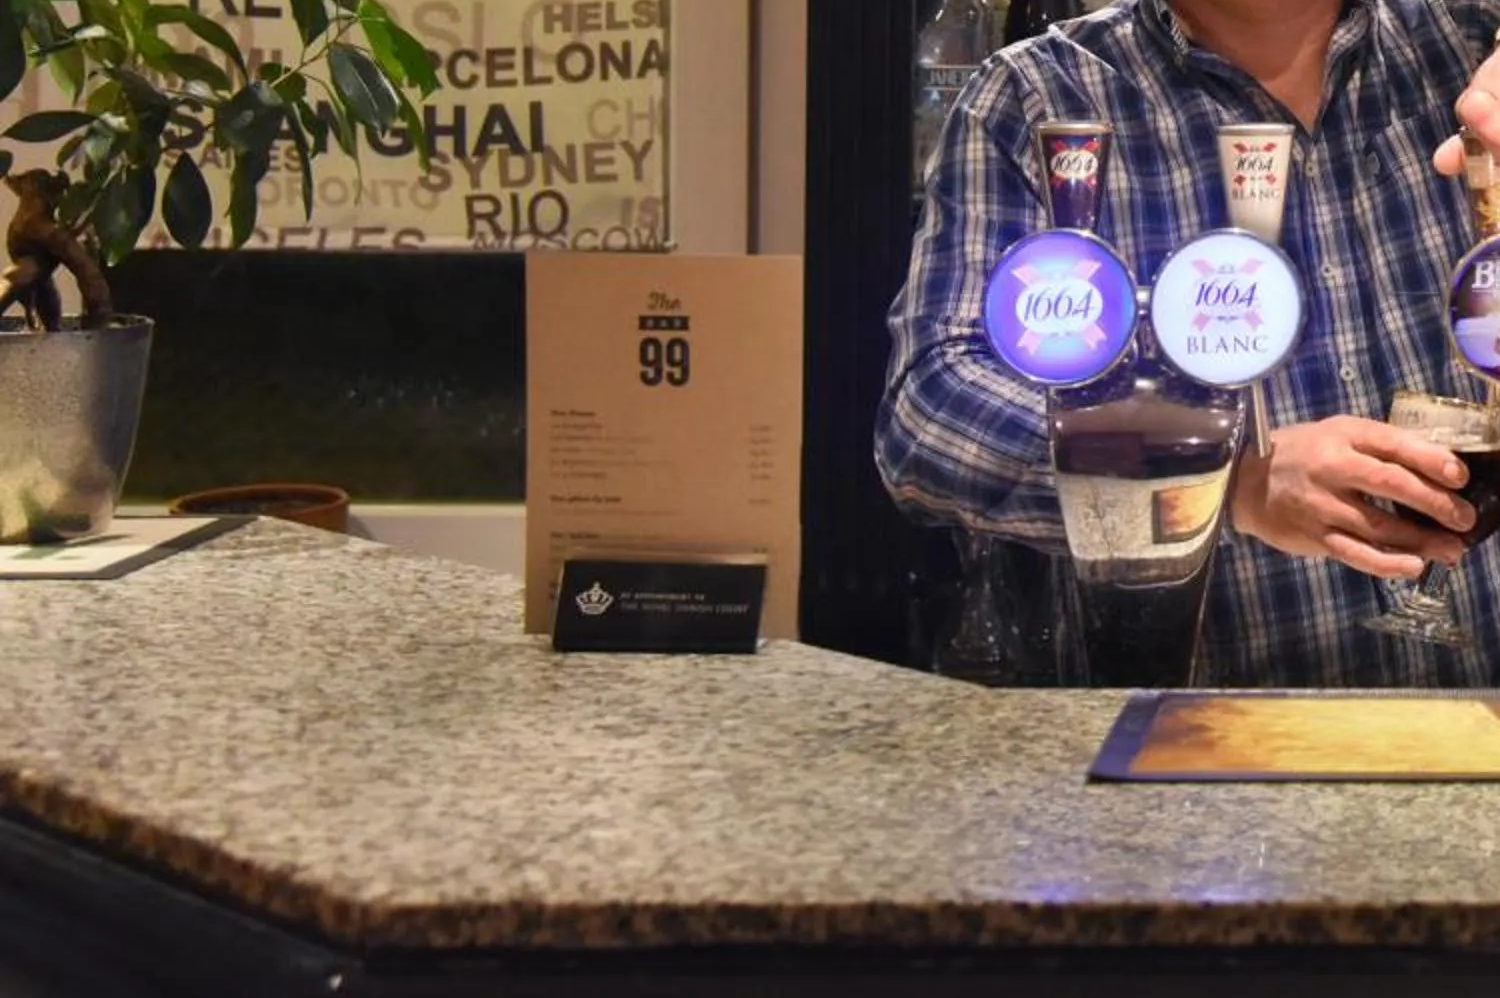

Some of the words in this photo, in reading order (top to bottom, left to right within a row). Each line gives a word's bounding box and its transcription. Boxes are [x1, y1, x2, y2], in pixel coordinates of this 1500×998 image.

[419, 139, 653, 193] SYDNEY
[1232, 186, 1280, 201] BLANC
[465, 189, 569, 241] RIO
[1024, 287, 1094, 322] 1664
[1195, 280, 1259, 308] 1664
[640, 337, 690, 387] 99
[1186, 335, 1269, 355] BLANC
